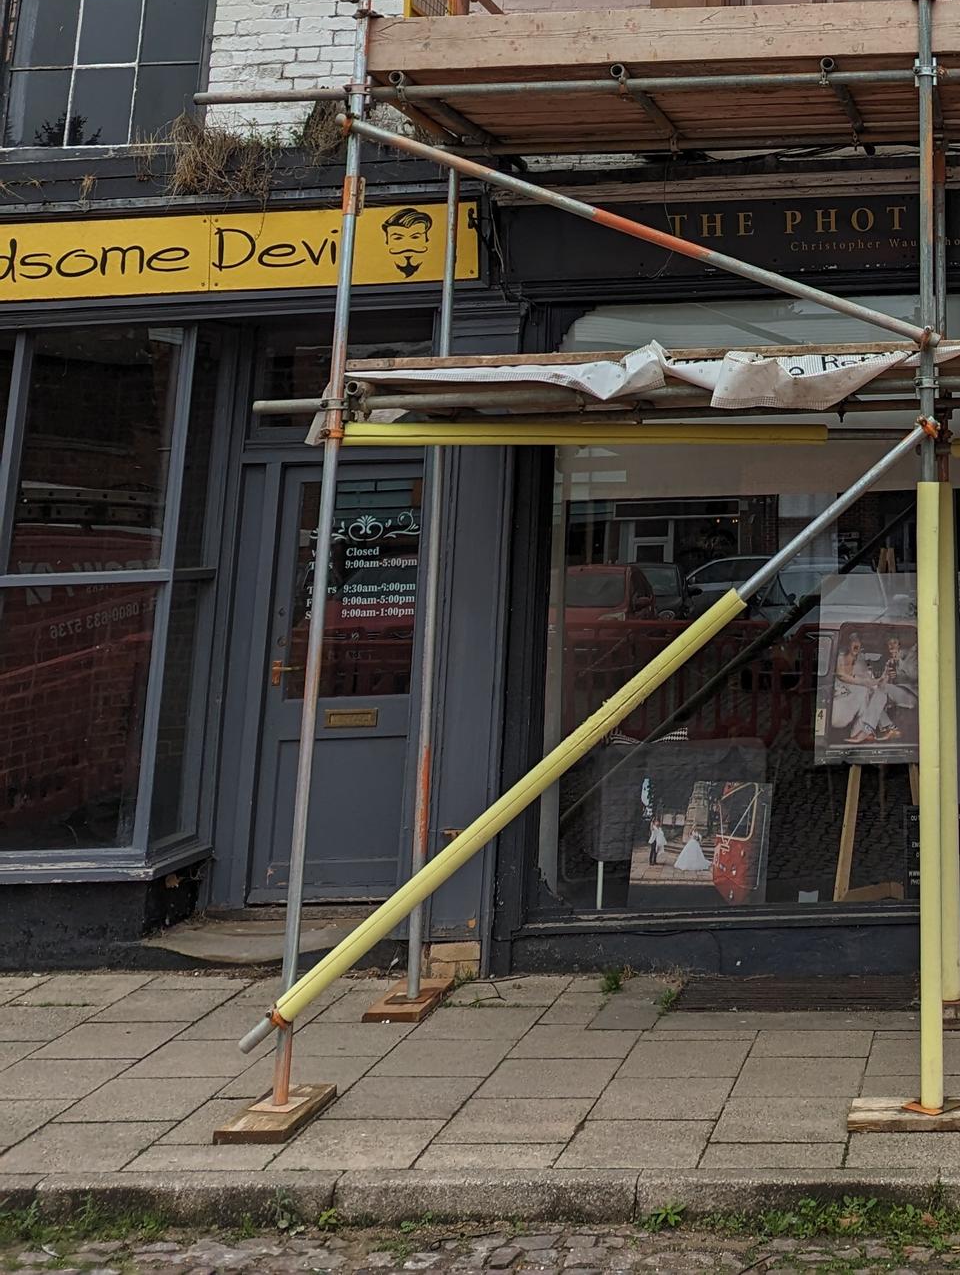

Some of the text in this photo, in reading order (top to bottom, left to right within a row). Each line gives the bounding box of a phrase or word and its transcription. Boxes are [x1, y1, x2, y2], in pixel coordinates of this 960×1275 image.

[667, 212, 755, 238] THE
[784, 206, 907, 234] PHOT
[212, 228, 338, 271] Devi
[790, 239, 881, 252] Christopher
[889, 238, 917, 248] Wau
[346, 547, 380, 557] Closed
[345, 558, 418, 569] 9:00am-5:00pm
[342, 595, 415, 606] 9:00am-5:00pm
[341, 607, 415, 618] 9:00am-1:00pm
